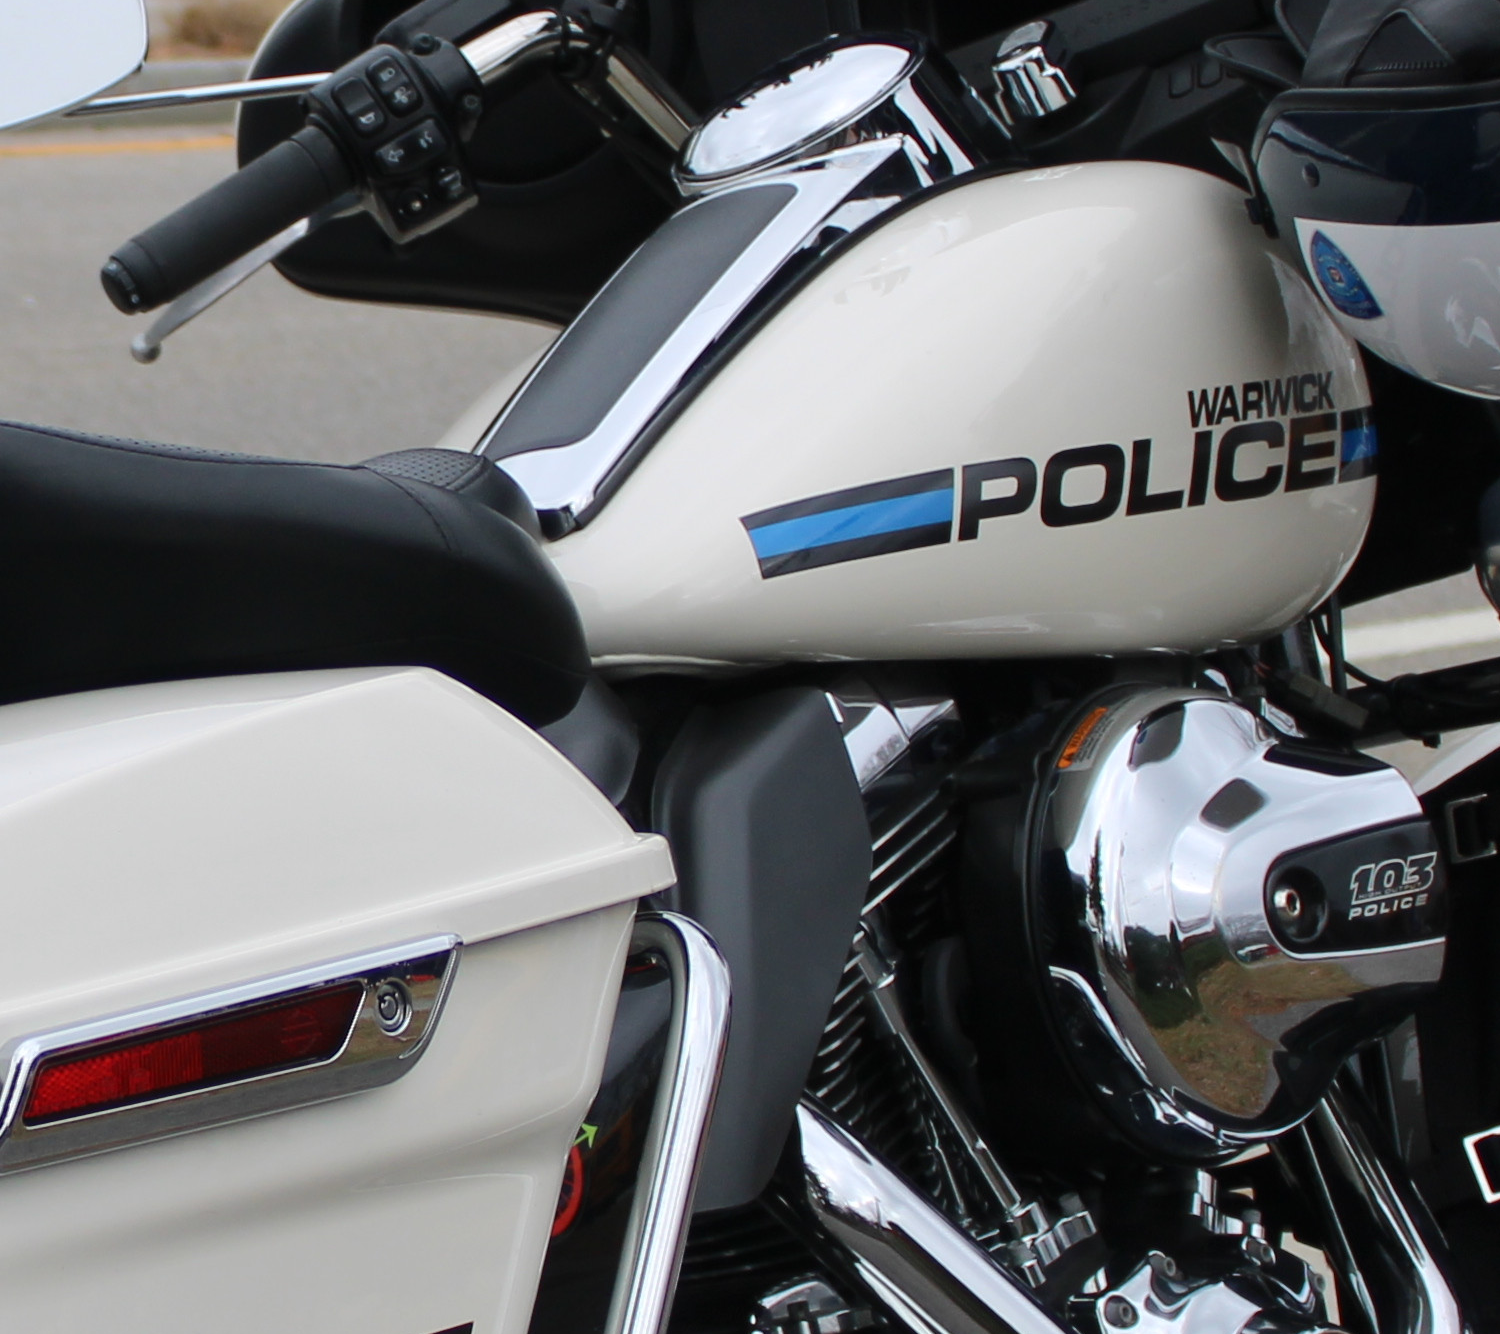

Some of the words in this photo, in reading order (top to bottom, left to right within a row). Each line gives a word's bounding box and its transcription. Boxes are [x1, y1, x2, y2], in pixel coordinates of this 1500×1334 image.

[1187, 371, 1335, 428] WARWICK
[958, 412, 1337, 541] POLICE
[1348, 893, 1428, 920] POLICE
[1349, 851, 1437, 906] 103
